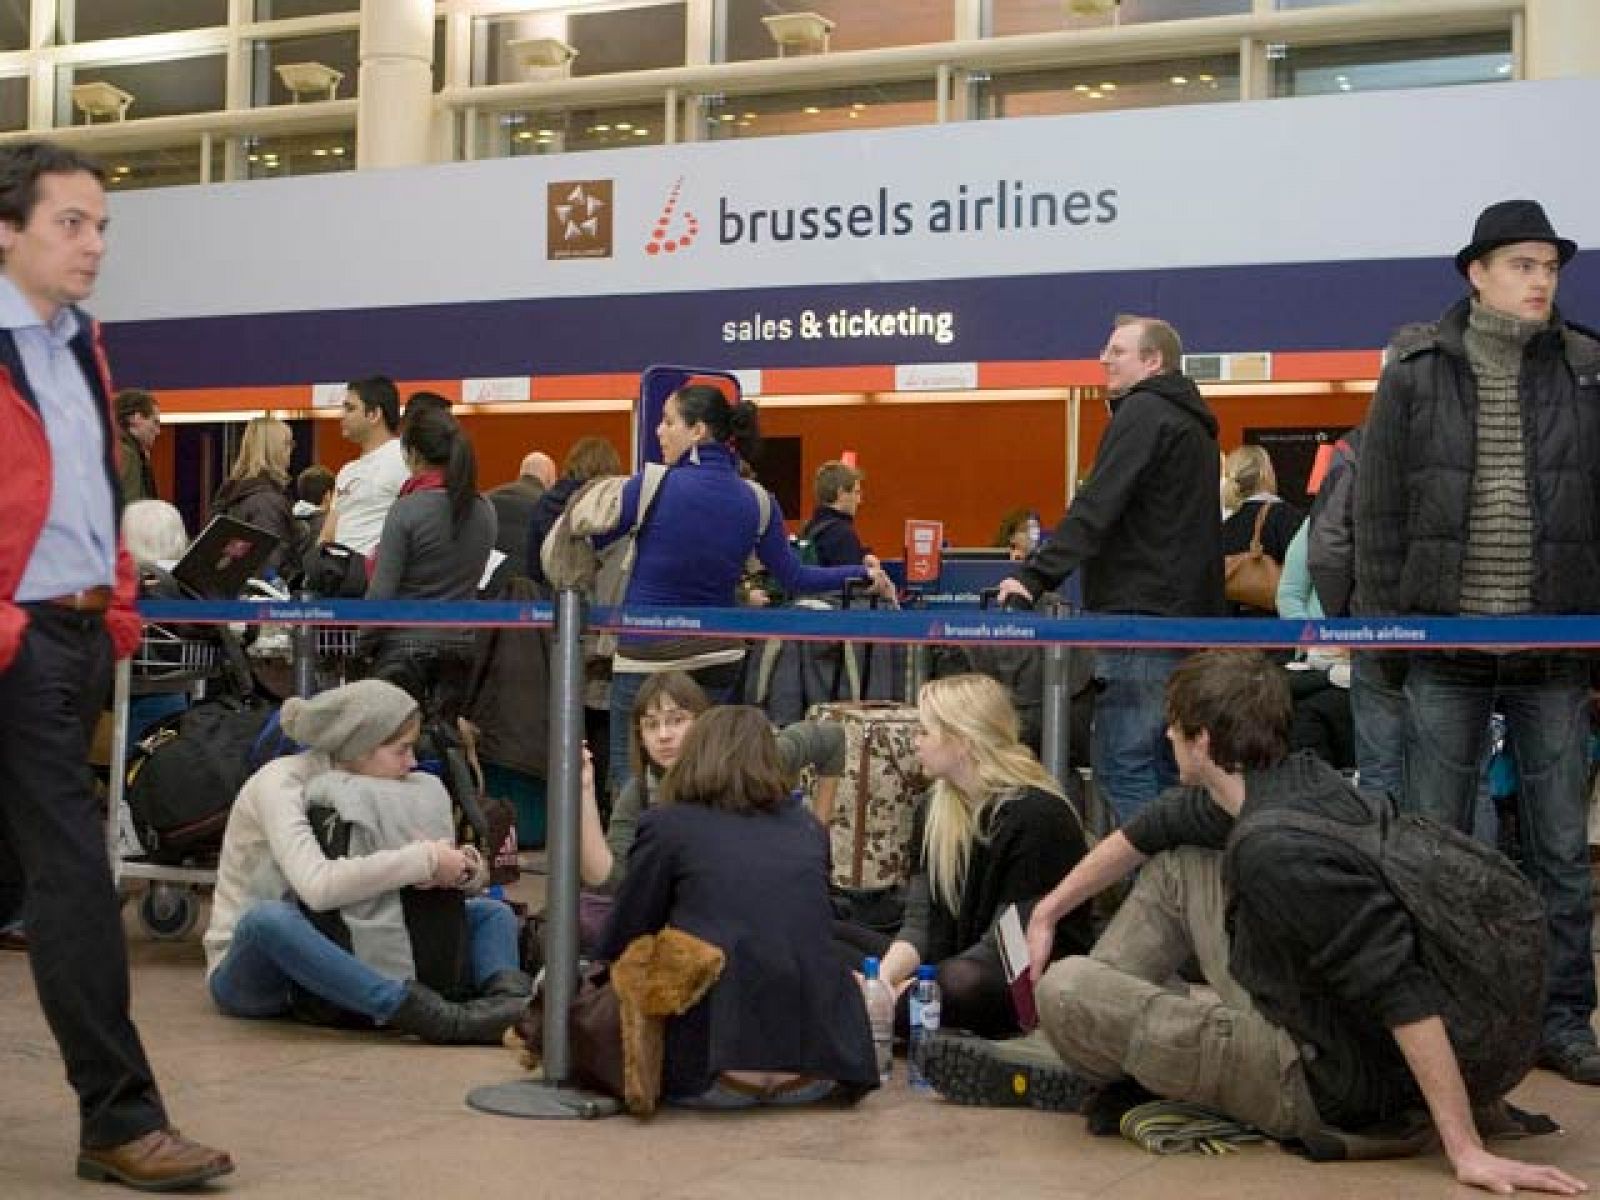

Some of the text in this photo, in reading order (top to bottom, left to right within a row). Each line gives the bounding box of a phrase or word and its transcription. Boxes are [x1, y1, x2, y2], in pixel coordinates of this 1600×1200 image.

[719, 186, 913, 246] brussels
[929, 179, 1118, 233] airlines
[722, 305, 954, 344] sales & ticketing
